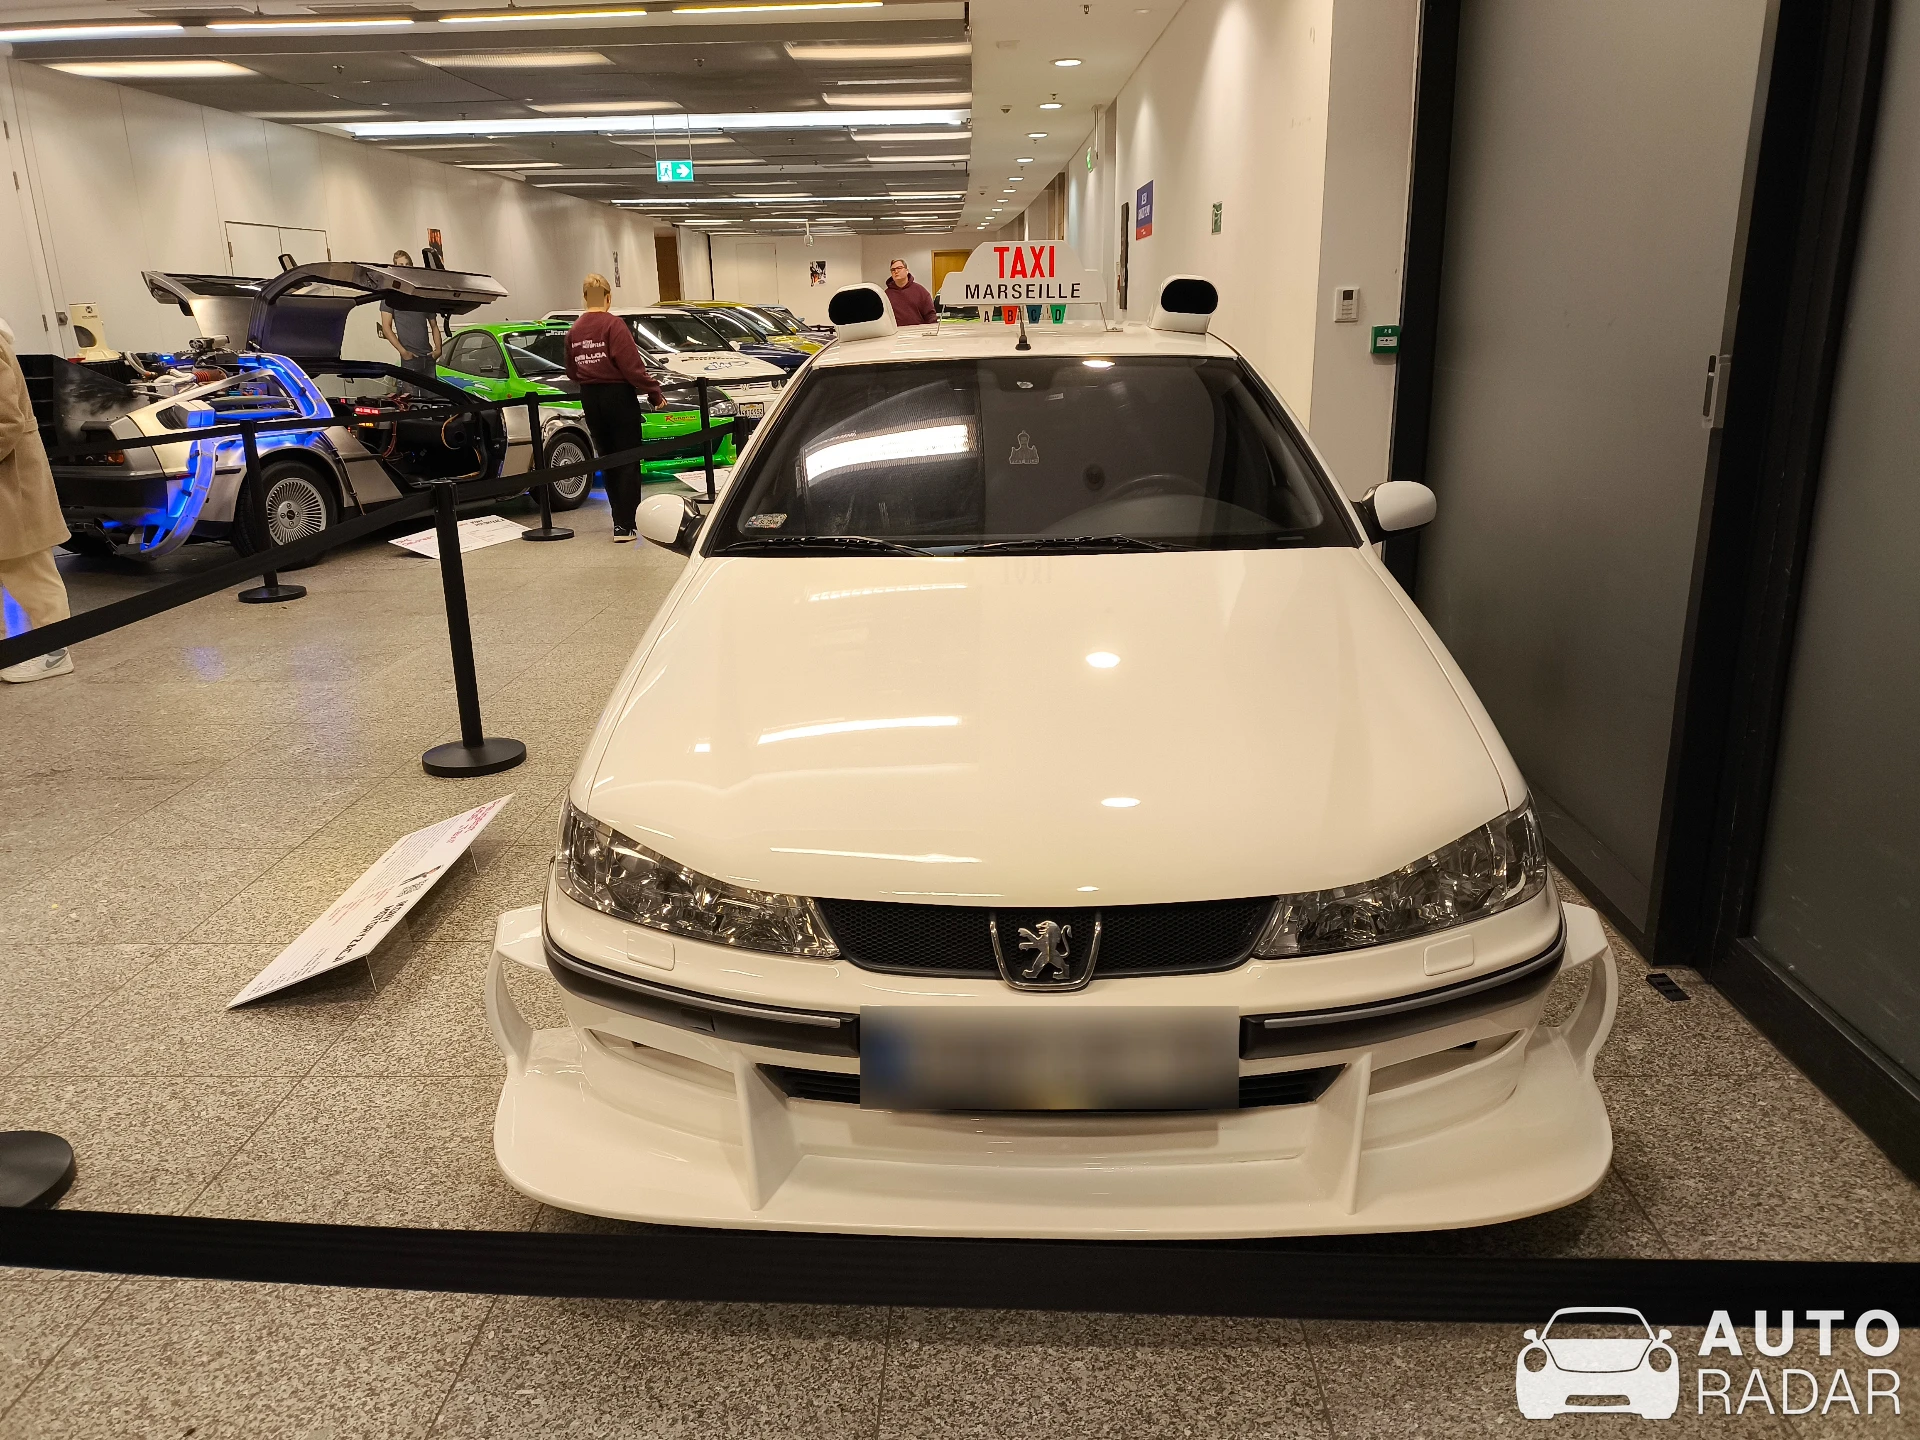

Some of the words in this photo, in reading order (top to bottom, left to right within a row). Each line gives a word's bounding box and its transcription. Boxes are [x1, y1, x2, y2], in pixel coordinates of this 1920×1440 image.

[993, 245, 1055, 279] TAXI
[965, 282, 1081, 300] MARSEILLE
[984, 311, 990, 323] A
[1007, 309, 1014, 322] B
[1031, 309, 1037, 321] C
[1055, 308, 1062, 321] D
